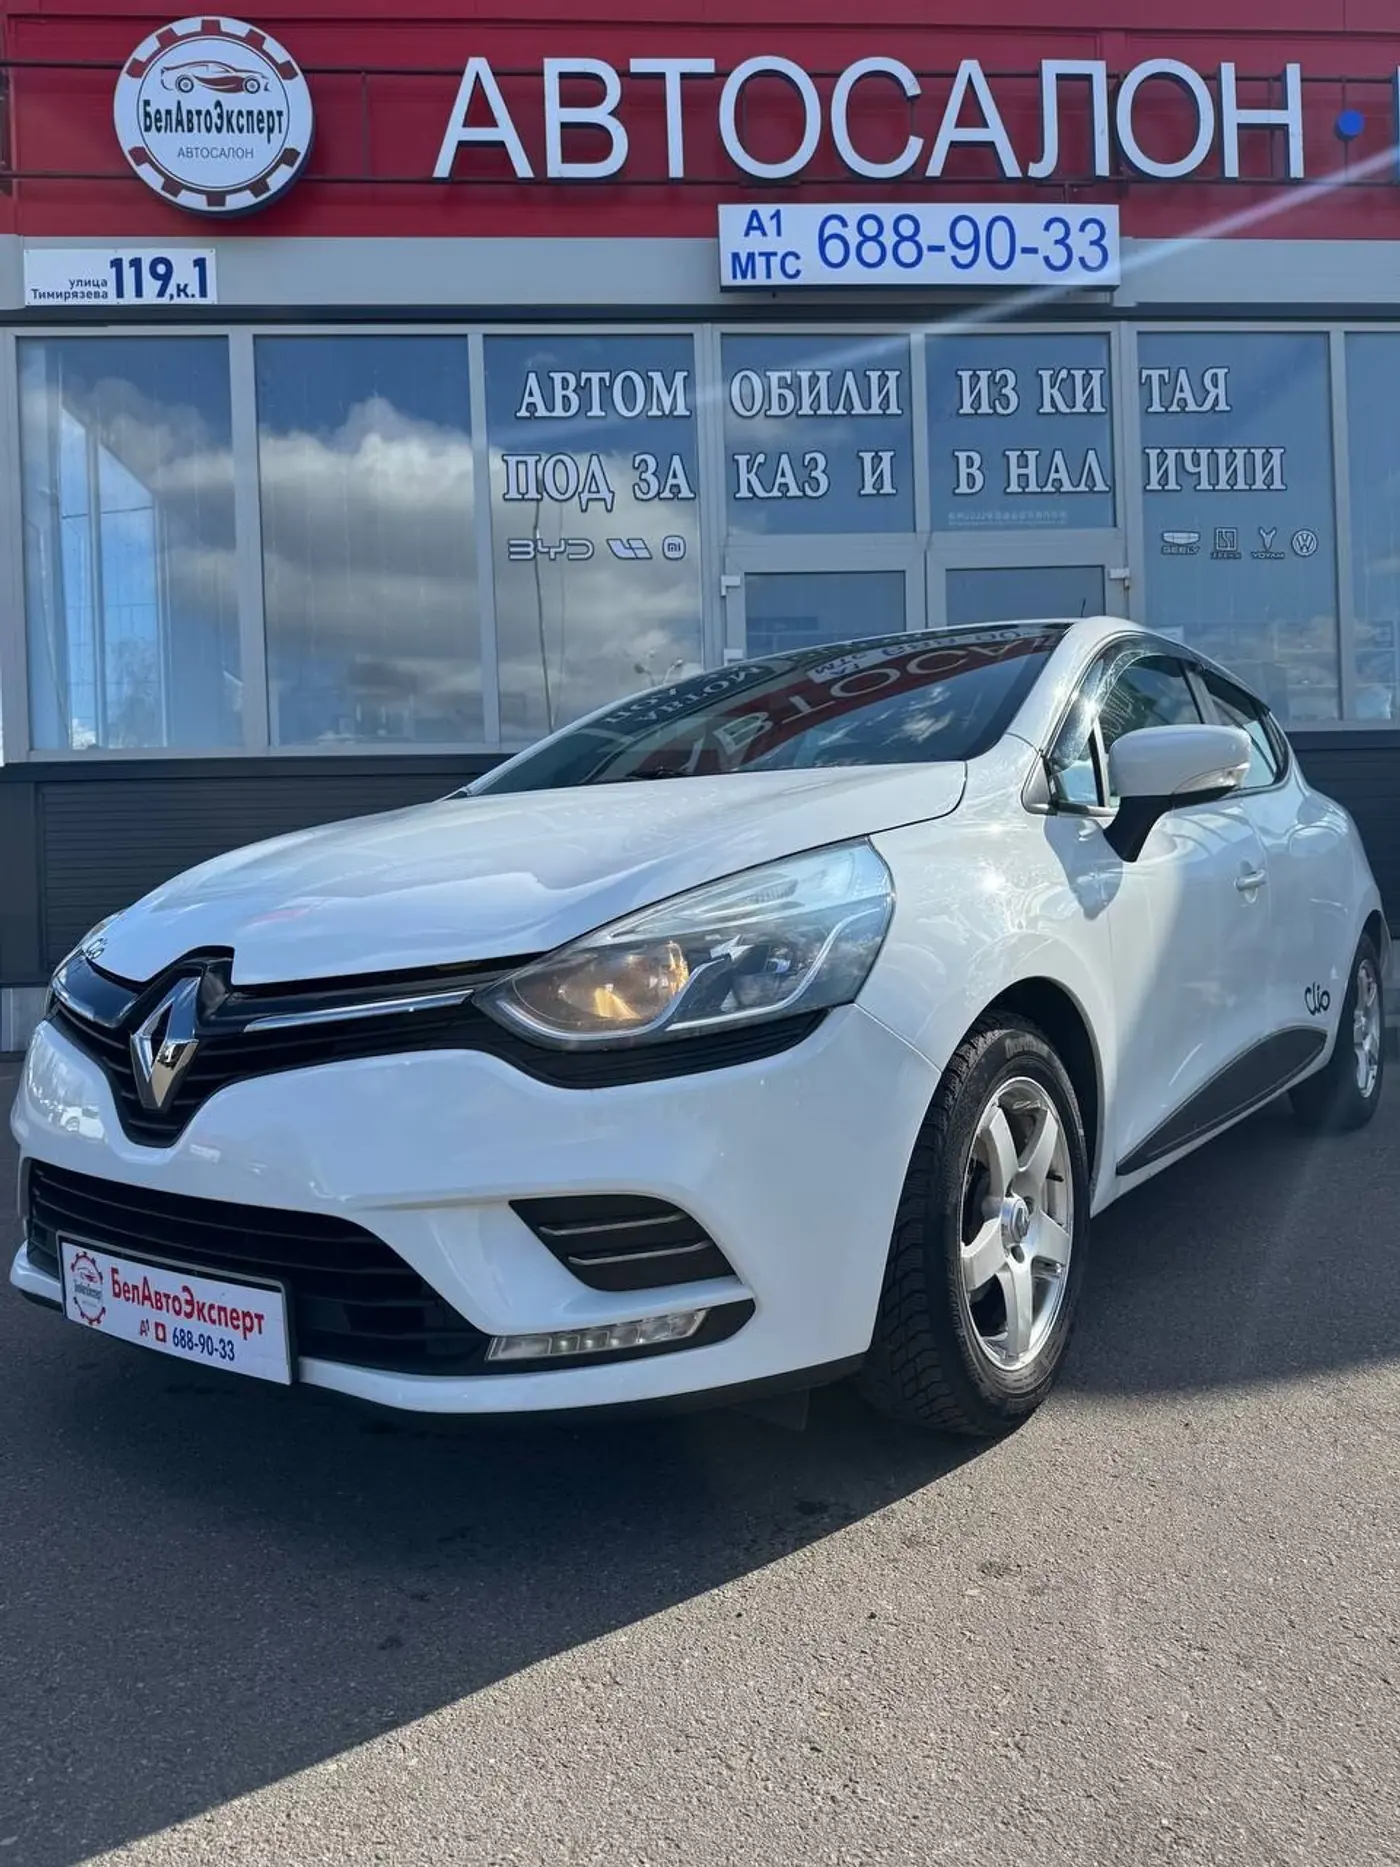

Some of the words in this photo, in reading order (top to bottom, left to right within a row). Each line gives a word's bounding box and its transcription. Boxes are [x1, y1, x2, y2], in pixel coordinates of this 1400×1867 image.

[143, 99, 284, 144] БелАвтоЭксперт
[432, 55, 1304, 180] АВТОСАЛОН
[177, 147, 254, 159] АВТОСАЛОН
[818, 213, 1109, 272] 688-90-33
[68, 278, 108, 290] улица
[731, 251, 801, 280] МТС
[31, 288, 108, 301] Тимирязева
[515, 369, 691, 418] АВТОМ
[730, 368, 902, 417] ОБИЛИ
[956, 368, 1019, 416] ИЗ
[1037, 368, 1107, 414] КИ
[1141, 367, 1232, 413] ТАЯ
[502, 452, 615, 512] ПОД
[633, 451, 696, 500] ЗА
[734, 450, 830, 500] КАЗ
[858, 450, 898, 497] И
[953, 449, 985, 495] В
[1004, 448, 1111, 493] НАЛ
[1143, 447, 1288, 491] ИЧИИ
[1304, 981, 1331, 1016] Clio
[110, 1265, 265, 1341] БелАвтоЭксперт
[172, 1326, 235, 1361] 688-90-33
